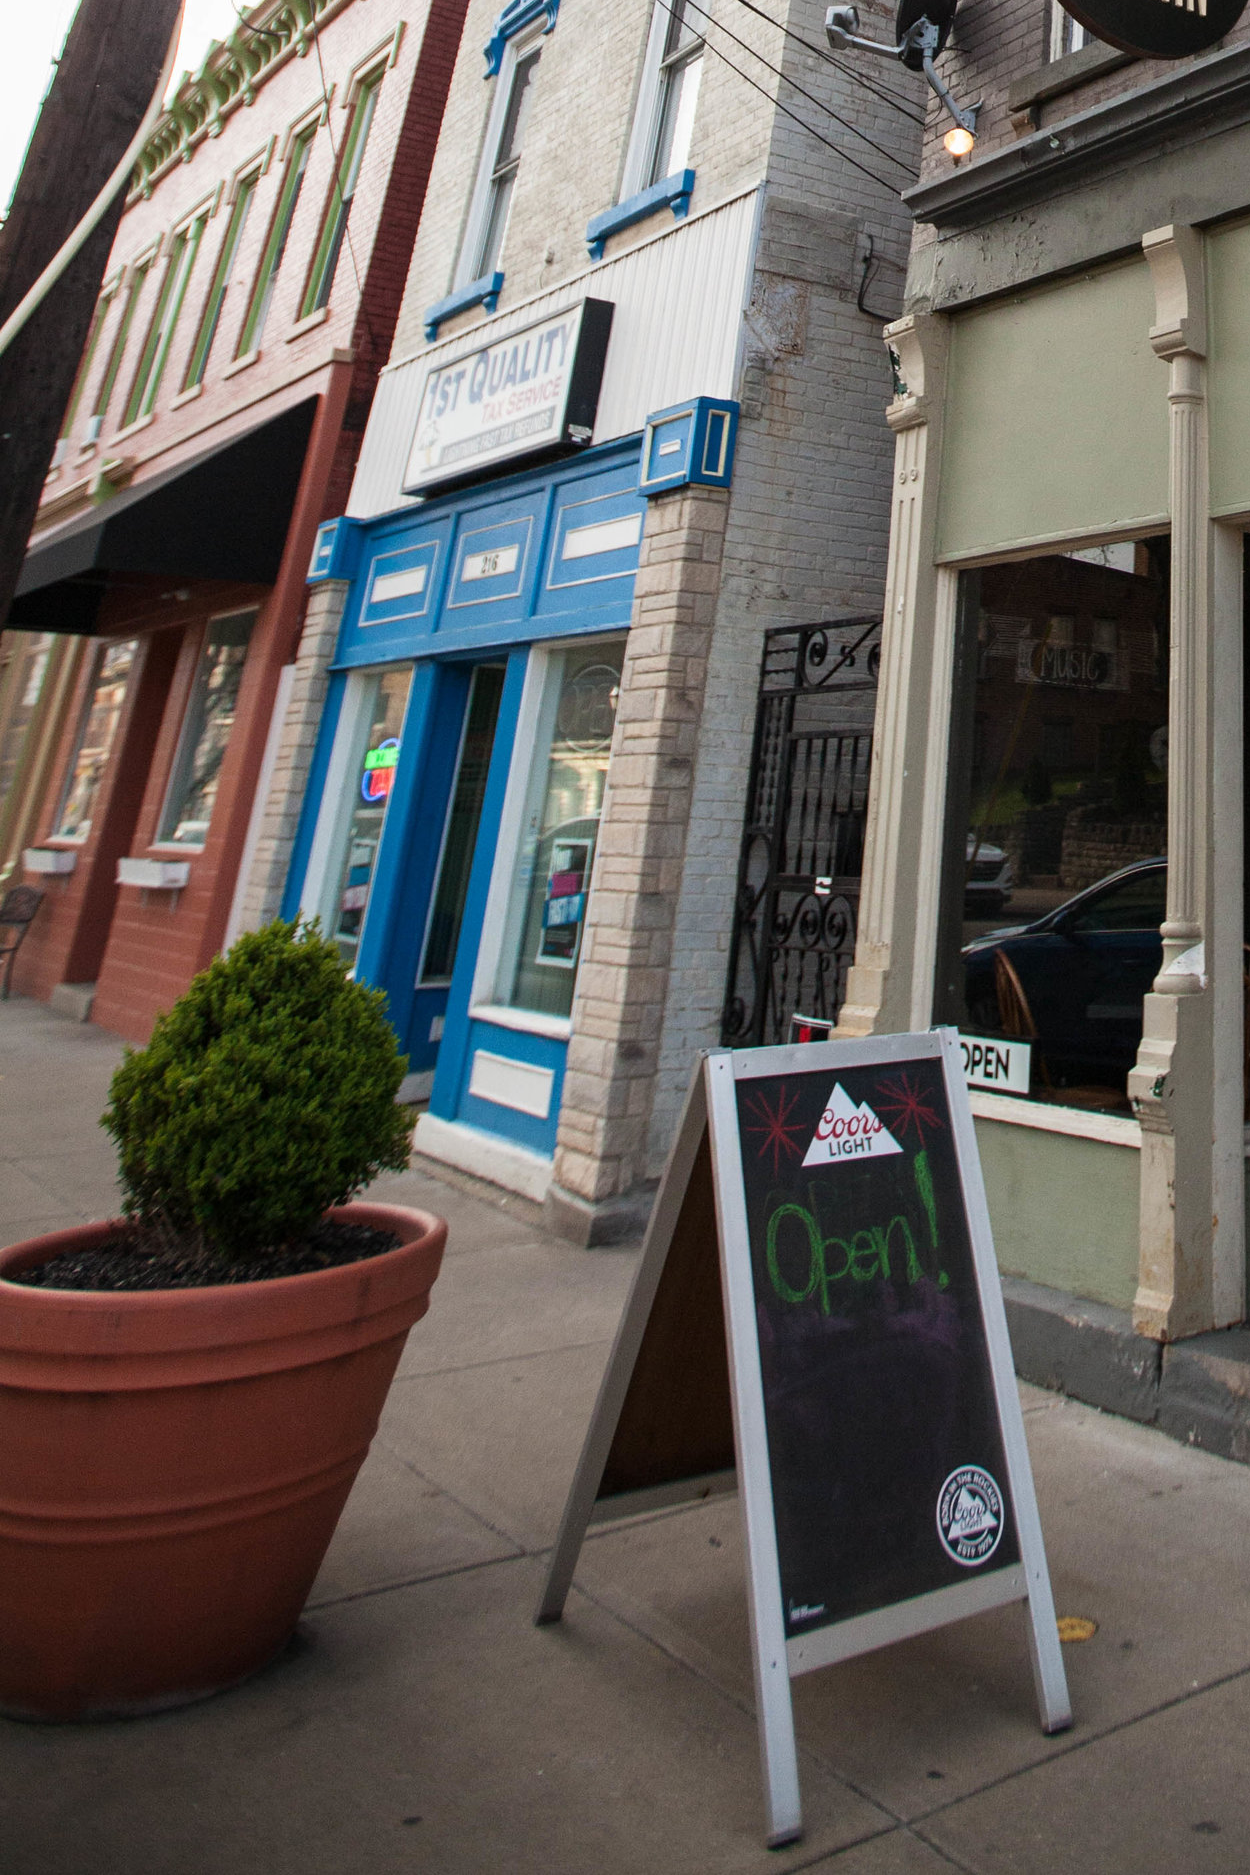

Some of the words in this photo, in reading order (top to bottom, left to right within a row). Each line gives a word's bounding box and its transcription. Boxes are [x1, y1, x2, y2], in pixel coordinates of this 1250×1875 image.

[426, 369, 467, 420] 1ST
[468, 319, 576, 404] QUALITY
[481, 398, 506, 424] TAX
[507, 376, 563, 417] SERVICE
[481, 554, 499, 574] 216
[1041, 645, 1100, 681] MUSIC
[814, 1108, 886, 1141] Coors
[828, 1137, 874, 1157] LIGHT
[766, 1149, 950, 1317] Open!
